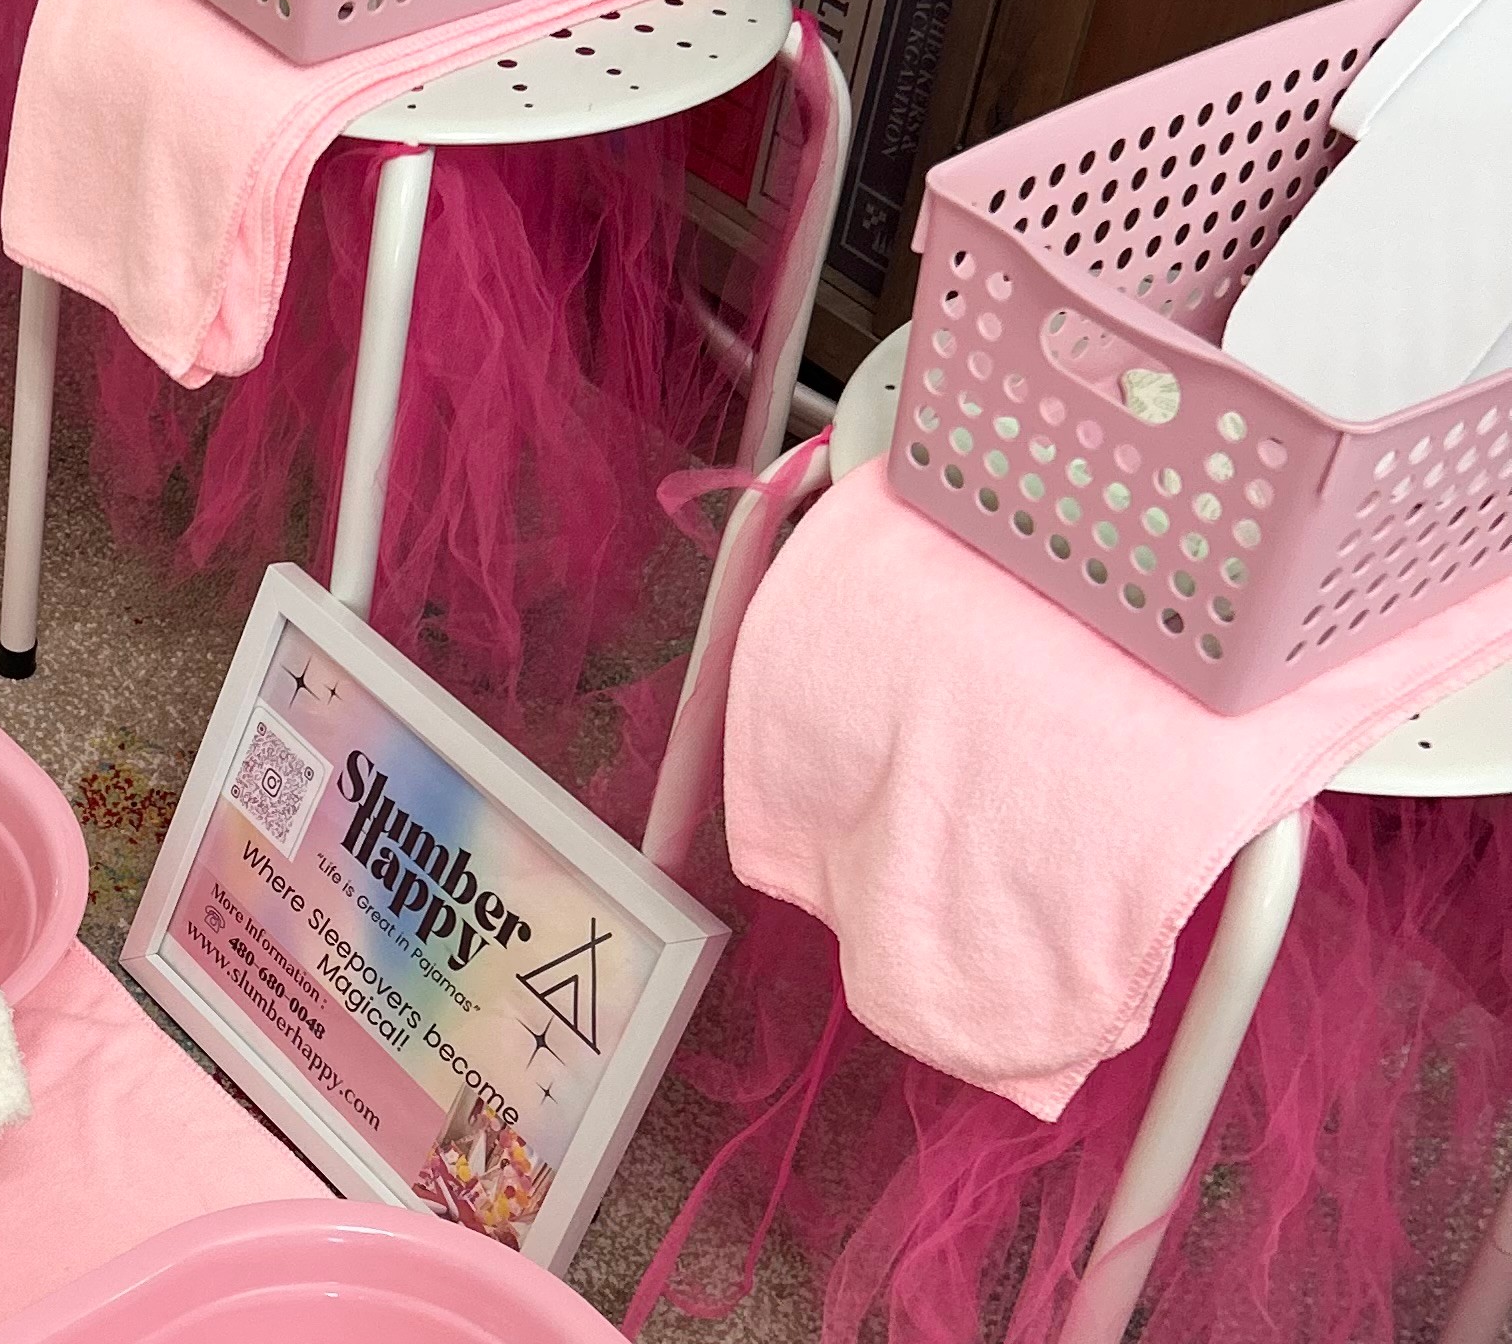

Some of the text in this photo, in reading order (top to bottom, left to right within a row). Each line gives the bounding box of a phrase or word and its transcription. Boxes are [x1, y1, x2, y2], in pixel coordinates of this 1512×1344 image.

[211, 883, 245, 923] More
[337, 750, 531, 949] Slumber
[340, 802, 490, 971] Happy
[342, 879, 356, 898] is
[356, 894, 395, 938] Great
[395, 930, 411, 952] in
[187, 920, 380, 1132] www.slumberhappy.com
[228, 936, 326, 1040] 480-680-0048
[242, 840, 519, 1125] Where Sleepovers become
[316, 953, 410, 1052] Magical!
